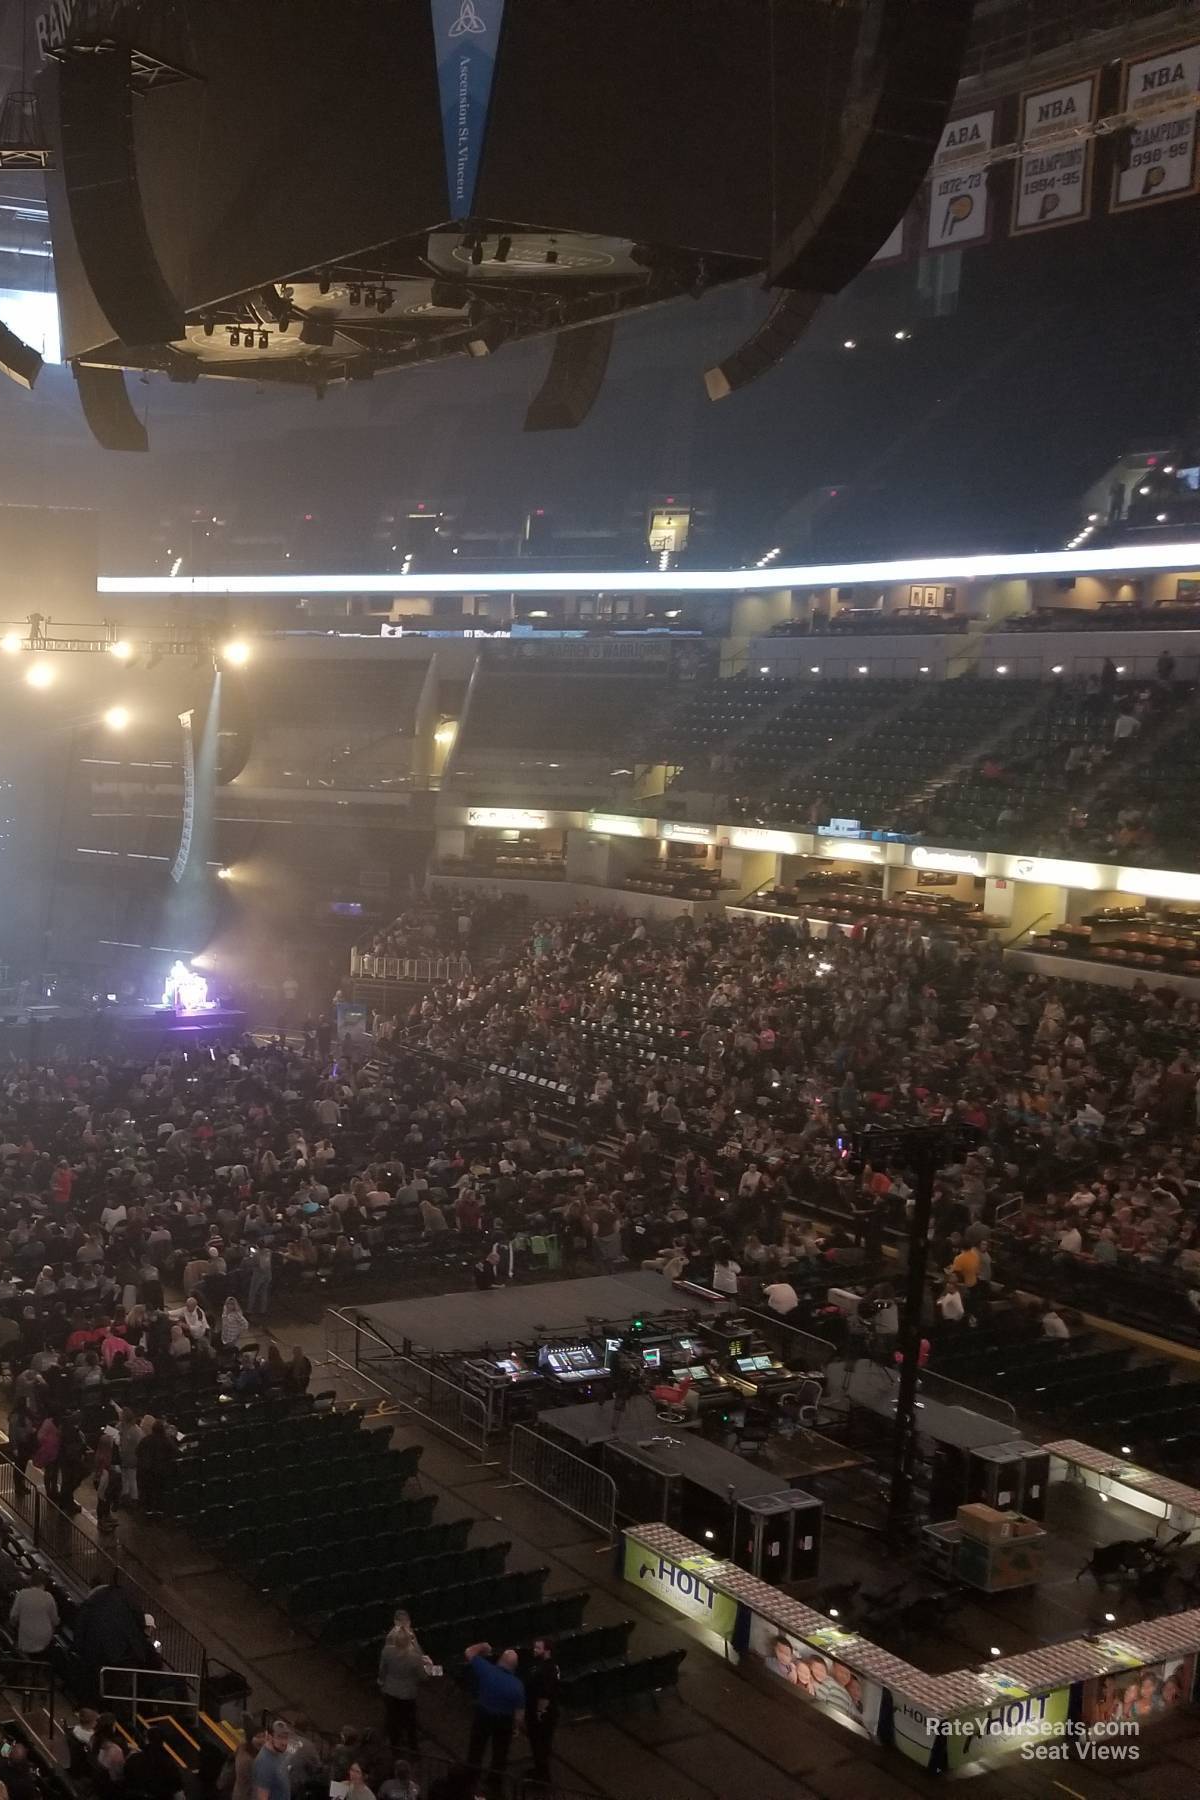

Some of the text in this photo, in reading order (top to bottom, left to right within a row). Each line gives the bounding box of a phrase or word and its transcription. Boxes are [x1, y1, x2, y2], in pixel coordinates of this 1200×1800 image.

[457, 55, 472, 126] Ascension
[1141, 62, 1185, 92] NBA
[1037, 96, 1076, 122] NBA
[945, 123, 981, 148] ABA
[456, 147, 469, 201] Vincent
[659, 1557, 713, 1609] HOLT
[987, 1695, 1051, 1732] HOLT
